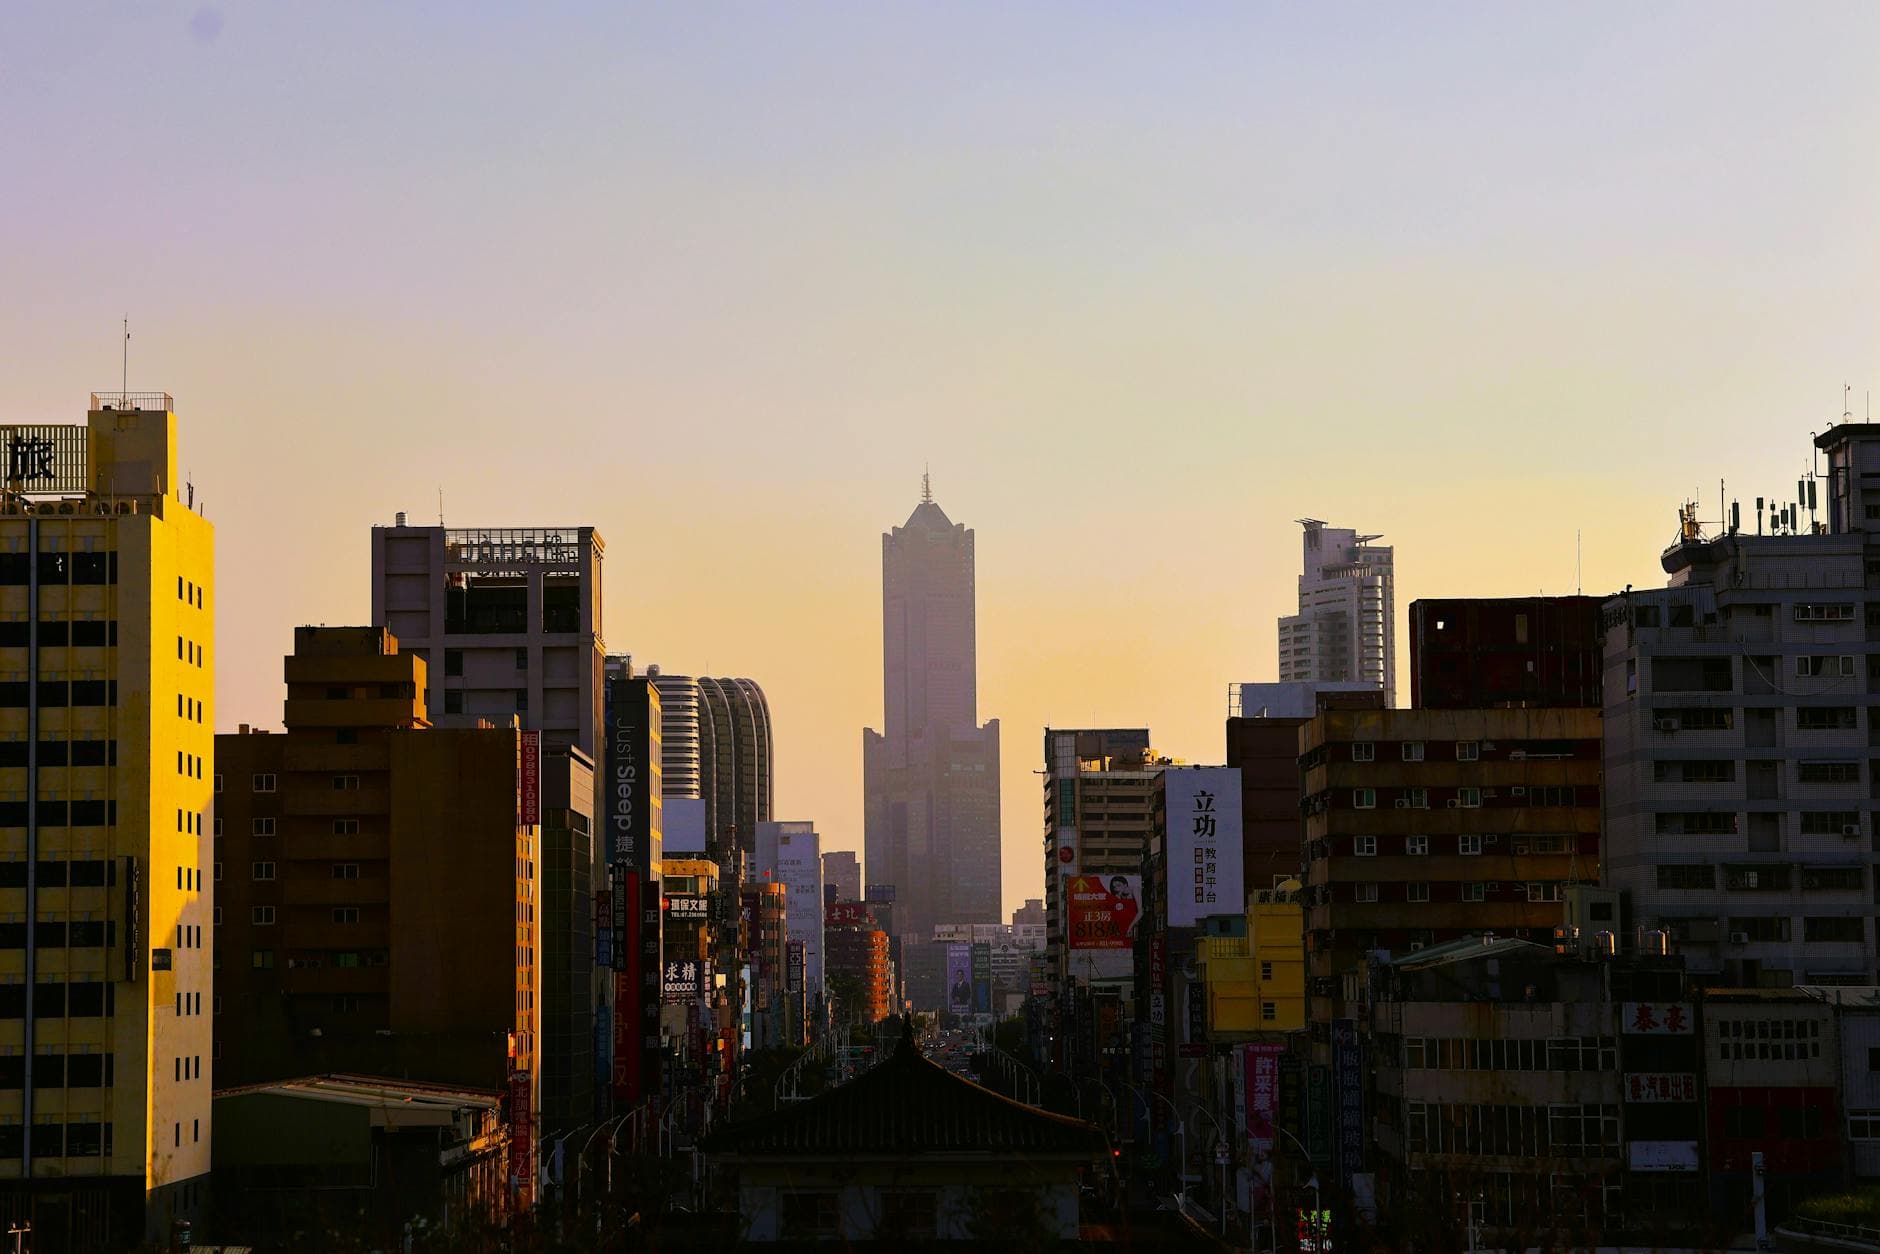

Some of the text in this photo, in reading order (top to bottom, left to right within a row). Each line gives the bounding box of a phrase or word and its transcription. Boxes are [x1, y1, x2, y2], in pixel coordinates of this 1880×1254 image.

[7, 436, 55, 481] 旅
[1193, 789, 1217, 838] 立功
[1205, 847, 1217, 904] 教育平台
